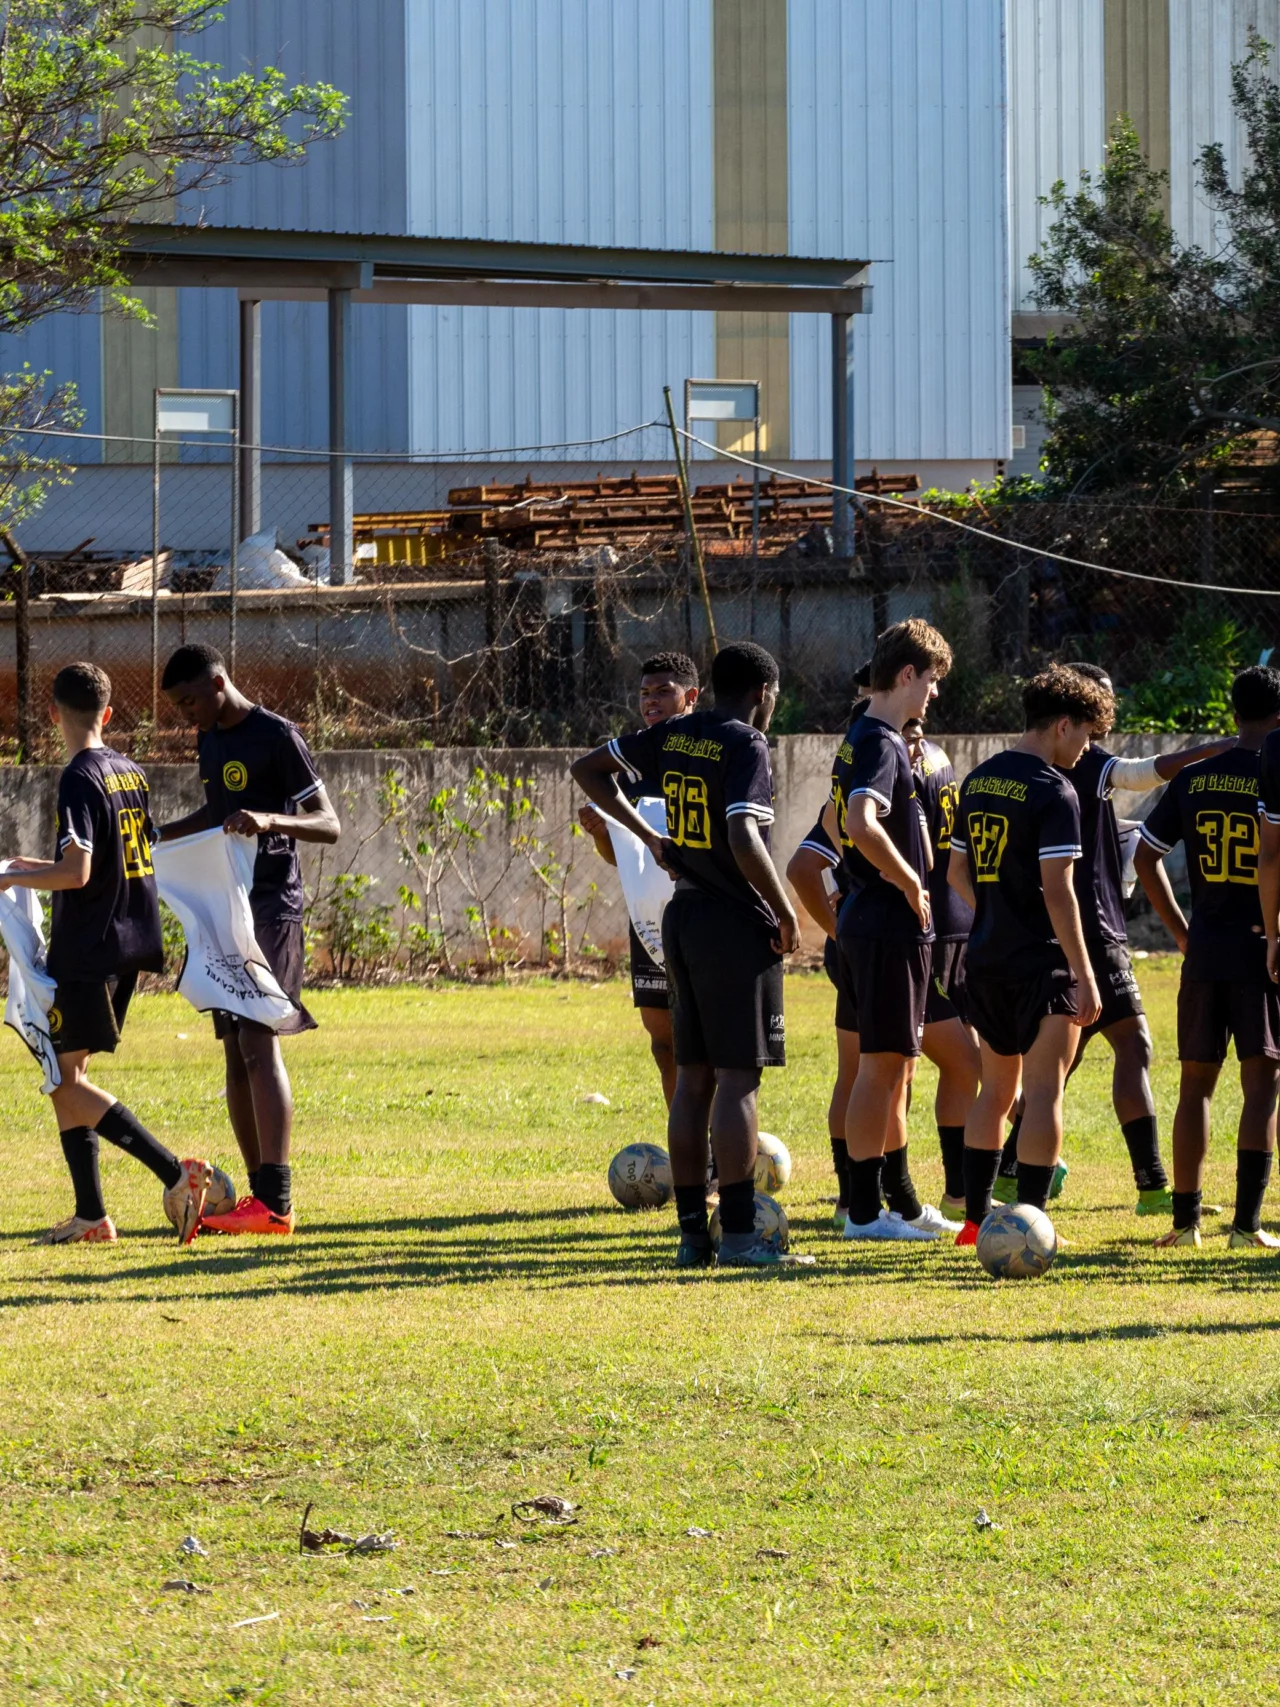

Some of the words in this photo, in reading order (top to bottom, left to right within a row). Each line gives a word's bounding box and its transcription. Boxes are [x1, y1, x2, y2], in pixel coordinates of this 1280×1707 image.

[662, 771, 712, 849] 36
[967, 811, 1009, 883] 27
[1196, 810, 1260, 886] 32
